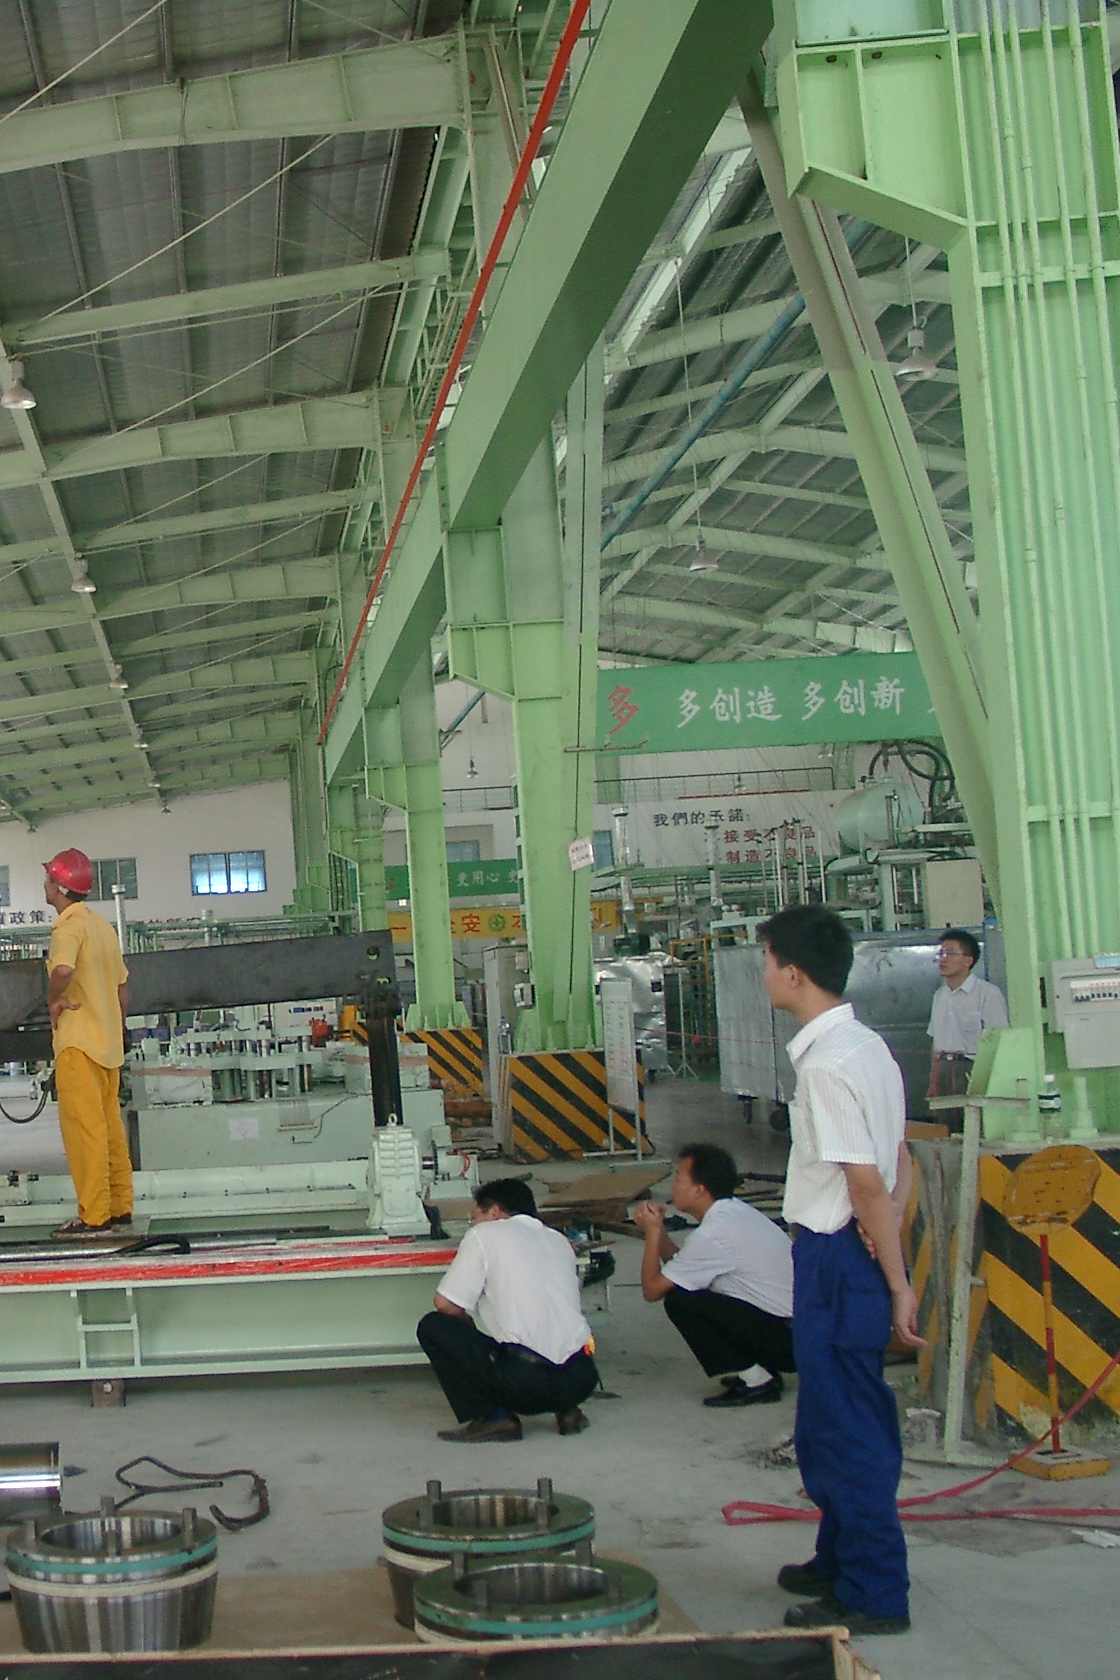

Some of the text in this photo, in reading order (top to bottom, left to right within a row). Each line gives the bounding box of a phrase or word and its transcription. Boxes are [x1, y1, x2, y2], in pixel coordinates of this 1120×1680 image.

[608, 676, 905, 736] 多 多创造 多创新
